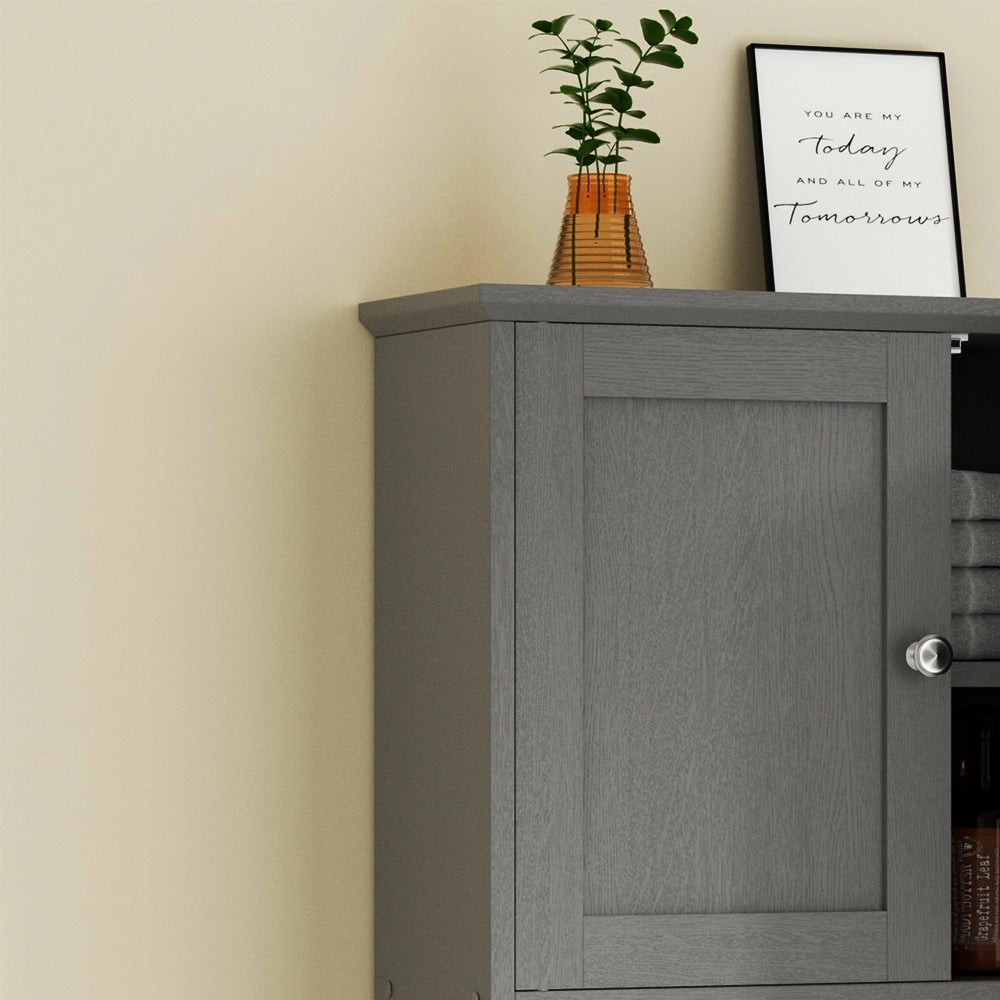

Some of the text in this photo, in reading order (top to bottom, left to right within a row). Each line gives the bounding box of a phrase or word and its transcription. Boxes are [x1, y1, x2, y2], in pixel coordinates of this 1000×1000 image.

[804, 110, 902, 121] YOU ARE MY
[798, 133, 907, 171] Today
[796, 177, 828, 185] AND
[837, 178, 865, 187] ALL
[902, 180, 922, 188] MY
[773, 200, 950, 225] Tomorrows
[976, 854, 991, 880] Leaf
